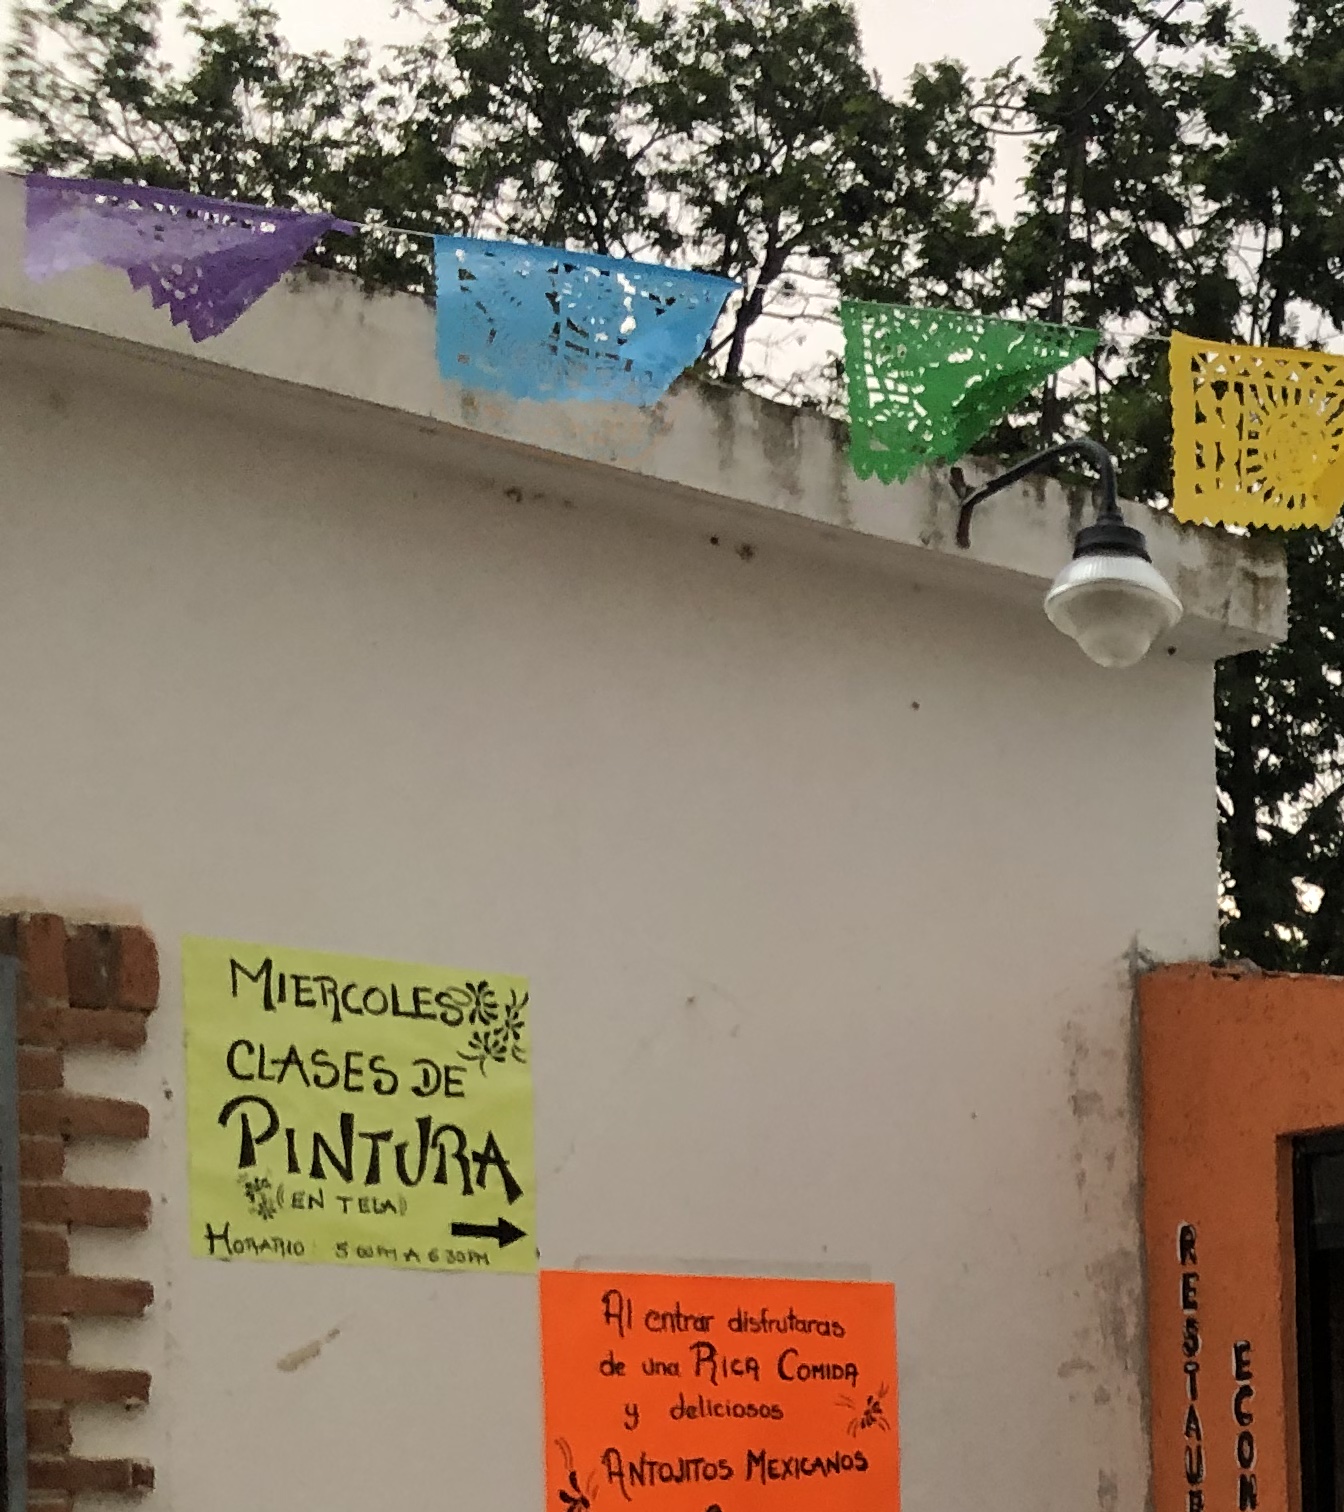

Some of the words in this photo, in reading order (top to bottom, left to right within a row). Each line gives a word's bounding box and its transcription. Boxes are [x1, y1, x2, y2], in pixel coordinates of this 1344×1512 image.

[229, 956, 465, 1027] MIERCOLES
[226, 1038, 400, 1095] CLASES
[411, 1057, 468, 1099] DE
[218, 1094, 525, 1206] PINTURA
[601, 1288, 633, 1338] Al
[643, 1301, 716, 1335] entrar
[727, 1304, 847, 1339] disfrutaras
[599, 1349, 627, 1378] de
[641, 1357, 681, 1378] una
[689, 1340, 761, 1387] RICA
[777, 1347, 860, 1388] COMIDA
[624, 1401, 641, 1431] y
[669, 1391, 785, 1421] deliciosos
[600, 1446, 735, 1502] ANTOJITOS
[745, 1447, 870, 1487] MEXICANOS
